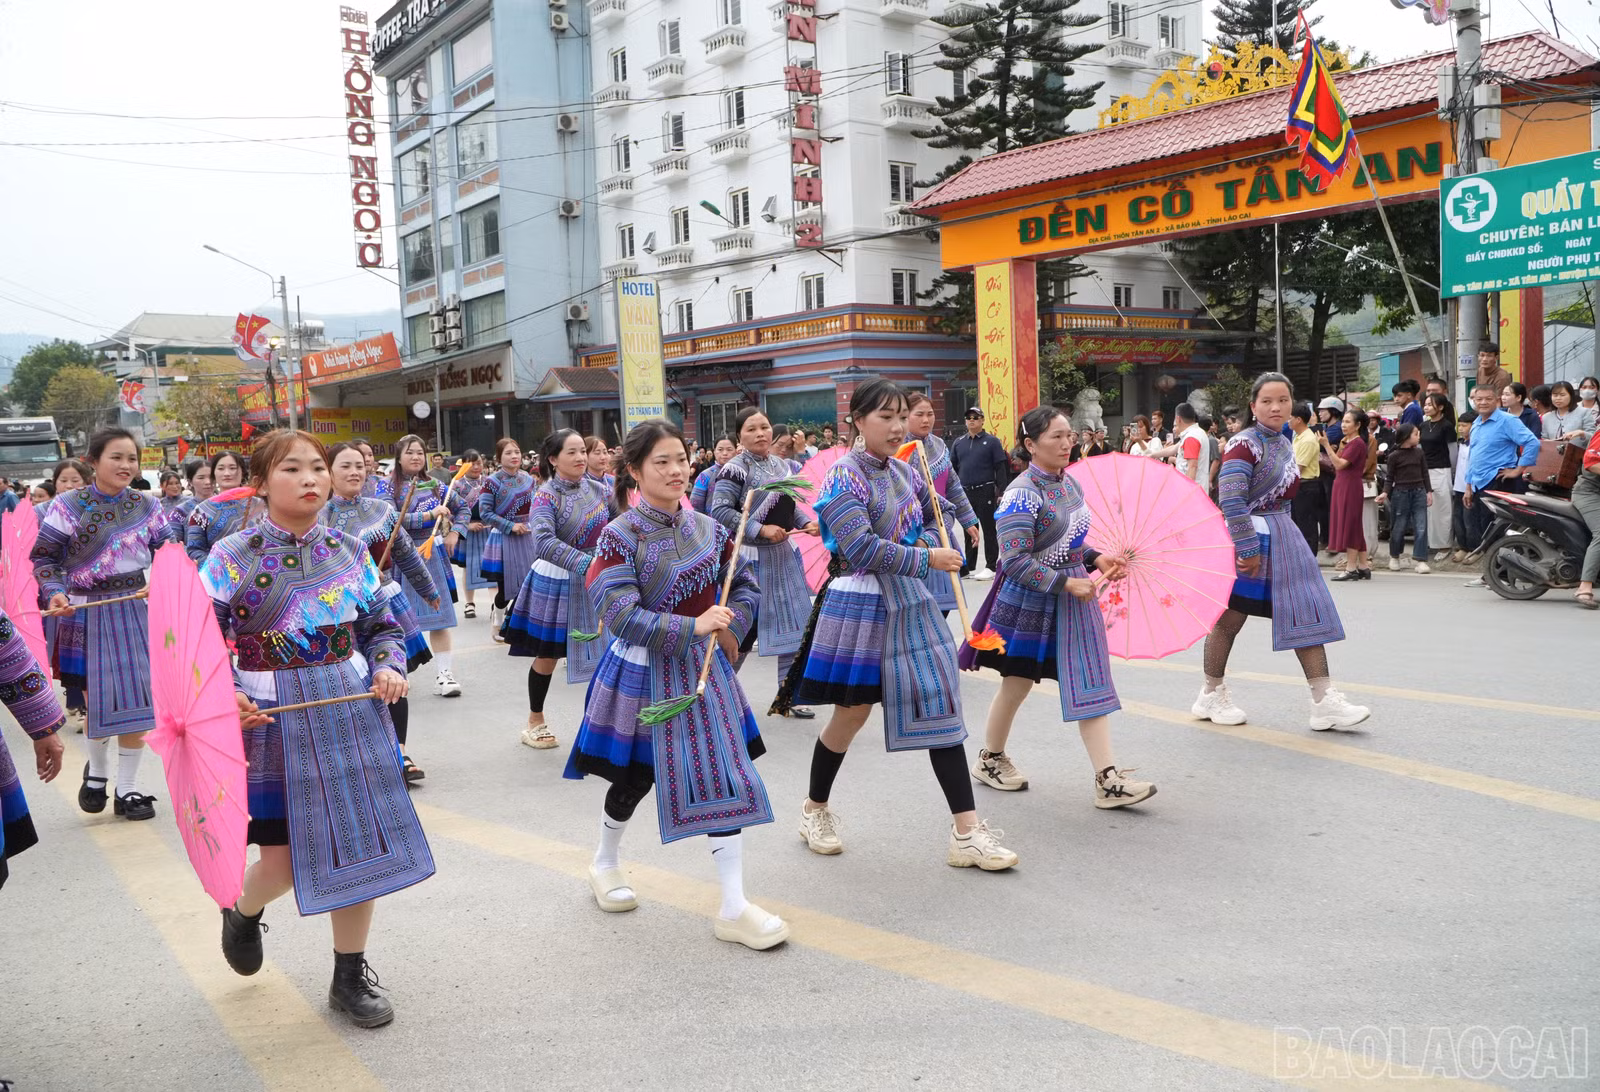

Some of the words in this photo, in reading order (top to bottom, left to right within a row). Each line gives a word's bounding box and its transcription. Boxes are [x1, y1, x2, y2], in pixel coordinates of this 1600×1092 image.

[341, 28, 376, 146] HỒNG
[784, 66, 823, 202] MINH
[1216, 165, 1328, 210] TÂN
[1354, 142, 1443, 188] AN
[351, 155, 383, 268] NGỌC
[795, 223, 823, 248] 2
[1113, 231, 1130, 240] THÔN
[1165, 224, 1174, 232] XÃ
[1479, 225, 1544, 245] CHUYÊN:
[1549, 218, 1583, 234] BÁN
[1565, 236, 1592, 249] NGÀY
[1466, 250, 1486, 262] GIẤY
[1527, 241, 1543, 254] SỐ:
[1527, 255, 1563, 270] NGƯỜI
[1566, 252, 1591, 265] PHỤ
[622, 282, 655, 296] HOTEL
[623, 332, 659, 353] MINH
[471, 362, 503, 389] NGỌC
